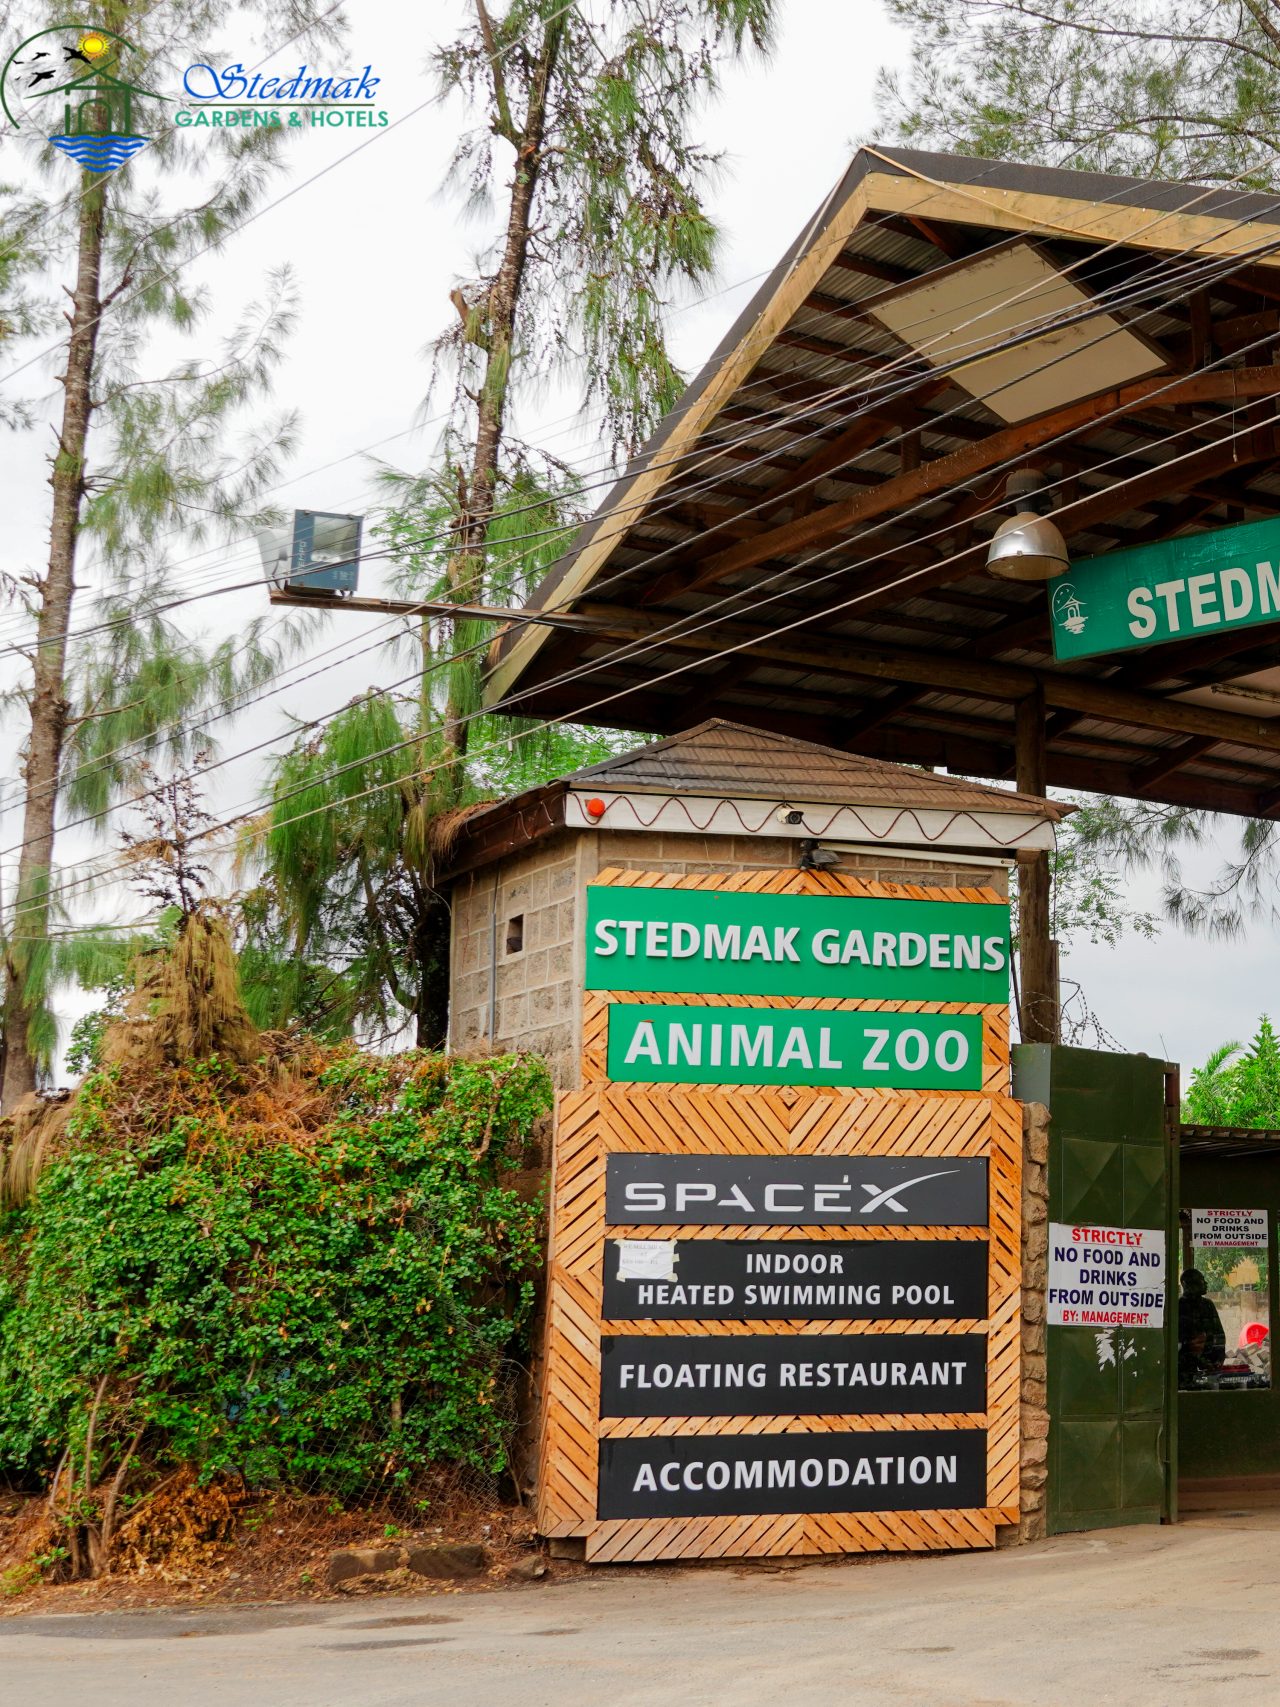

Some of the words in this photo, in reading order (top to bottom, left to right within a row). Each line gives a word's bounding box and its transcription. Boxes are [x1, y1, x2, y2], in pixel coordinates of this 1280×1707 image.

[594, 918, 800, 962] STEDMAK
[811, 928, 1006, 972] GARDENS
[623, 1021, 843, 1070] ANIMAL
[862, 1028, 969, 1072] ZOO
[623, 1169, 961, 1213] SPACEX
[1071, 1228, 1143, 1246] STRICTLY
[746, 1253, 844, 1275] INDOOR
[1054, 1247, 1078, 1262] NO
[1083, 1248, 1124, 1265] FOOD
[1128, 1251, 1161, 1268] AND
[1079, 1269, 1137, 1287] DRINKS
[637, 1285, 735, 1306] HEATED
[744, 1284, 881, 1306] SWIMMING
[891, 1285, 955, 1306] POOL
[1049, 1288, 1094, 1305] FROM
[1098, 1290, 1164, 1308] OUTSIDE
[1062, 1310, 1079, 1322] BY:
[1081, 1310, 1149, 1325] MANAGEMENT
[619, 1363, 767, 1389] FLOATING
[779, 1361, 967, 1388] RESTAURANT
[632, 1455, 958, 1493] ACCOMMODATION
